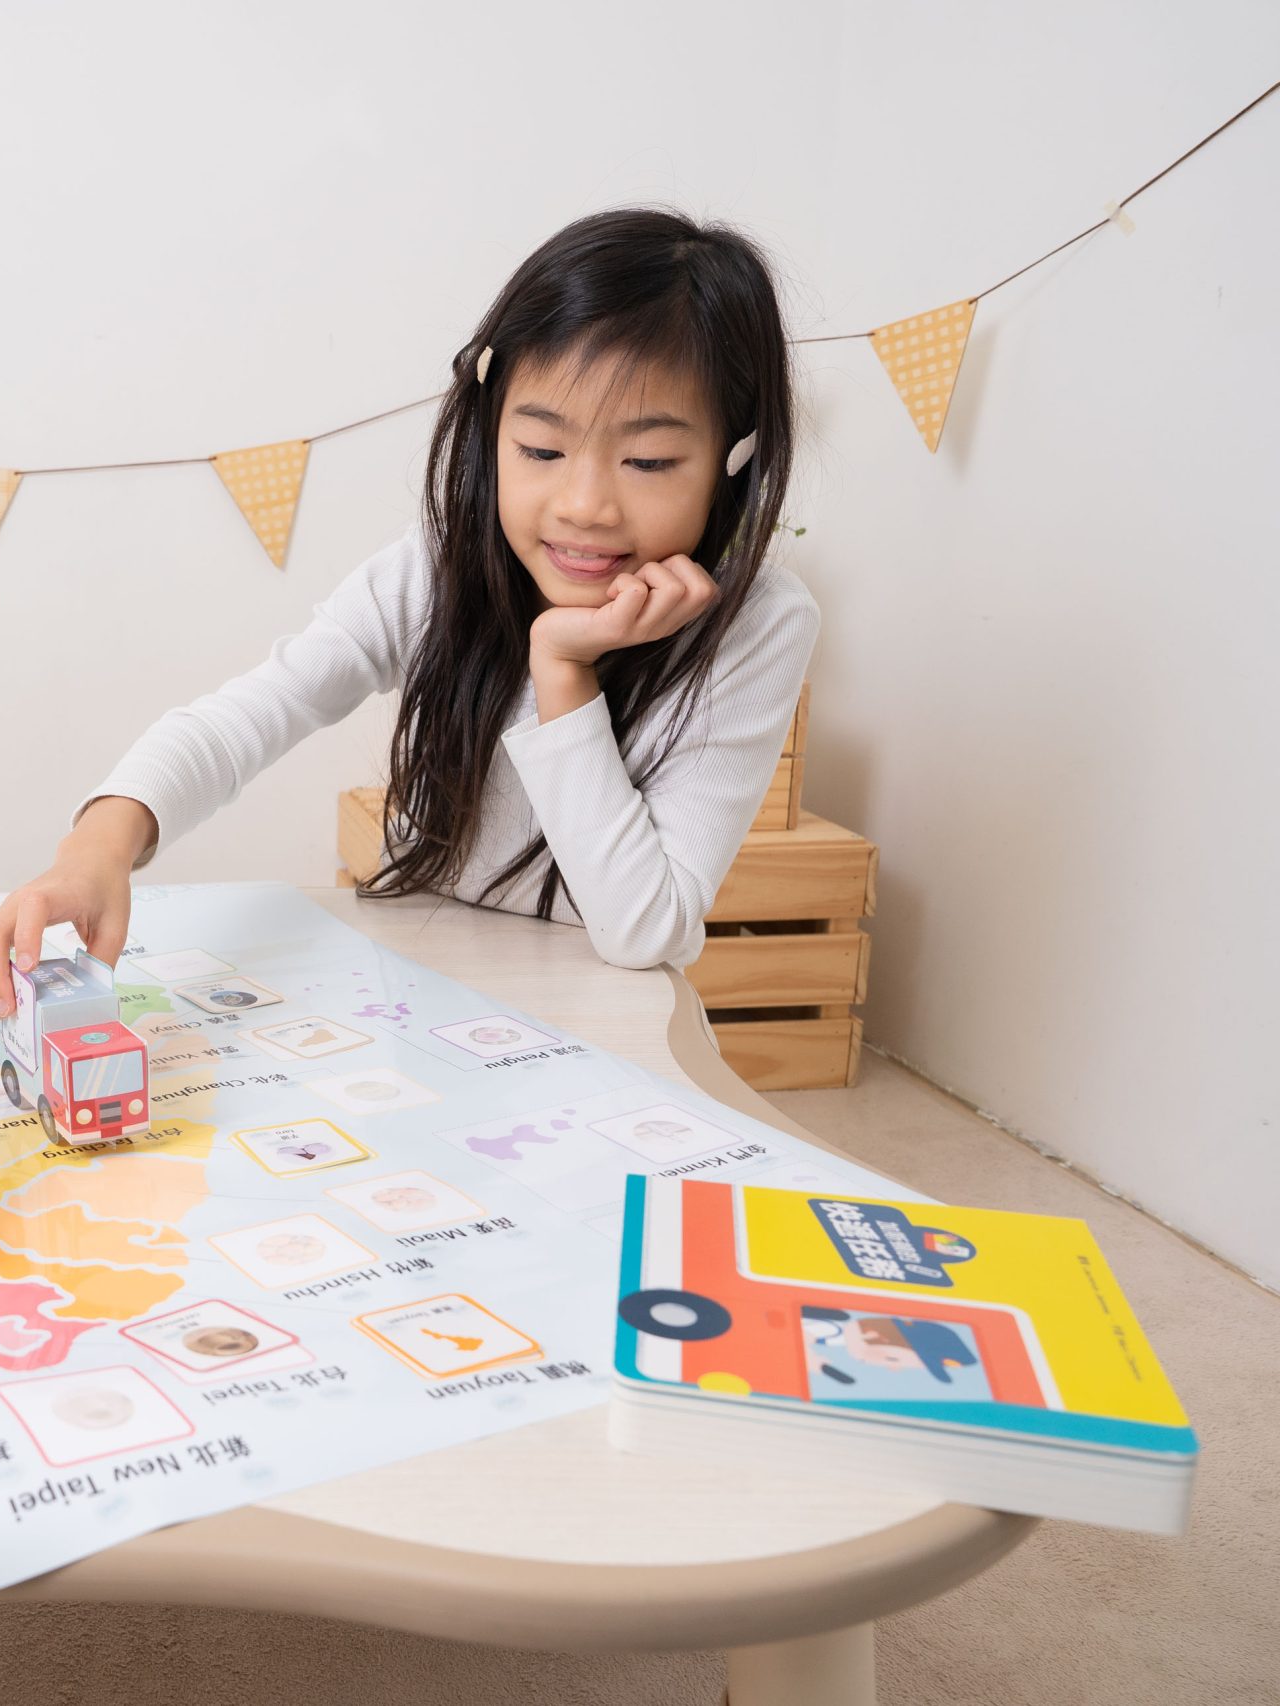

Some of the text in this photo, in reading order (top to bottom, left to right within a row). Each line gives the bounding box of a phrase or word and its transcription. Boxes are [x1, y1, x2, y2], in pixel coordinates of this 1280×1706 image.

[149, 1021, 202, 1034] Chiayi
[149, 1053, 199, 1065] Yunli
[484, 1044, 589, 1070] 澎湖 Penghu
[151, 1073, 288, 1102] 彰化 Changhua
[41, 1127, 183, 1159] 台中 Taichung
[726, 1144, 767, 1161] 金門
[396, 1216, 518, 1248] 苗栗 Miaoli
[819, 1202, 906, 1281] 快遞任務
[283, 1257, 434, 1301] 新竹 Hsinchu
[202, 1365, 348, 1407] 台北 Taipei
[425, 1360, 592, 1400] 桃園 Taoyuan
[9, 1435, 251, 1522] 新北 New Taipei
